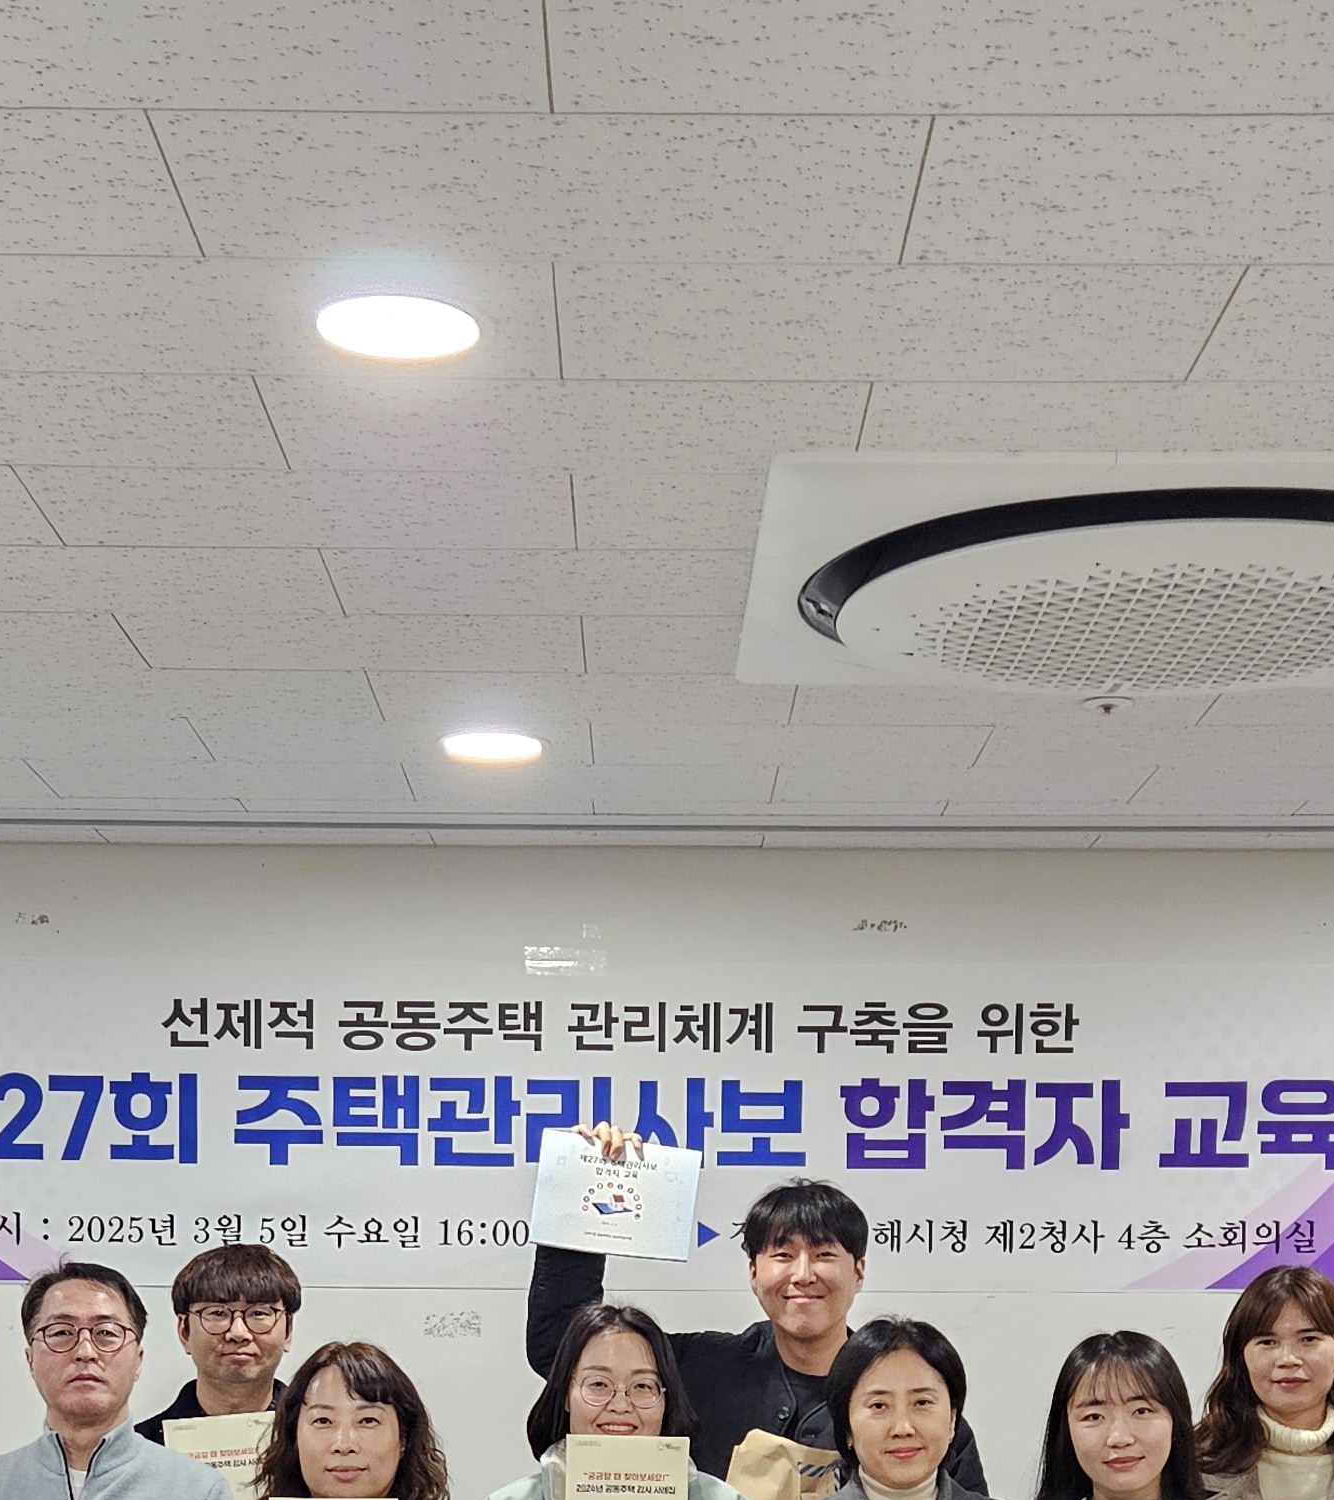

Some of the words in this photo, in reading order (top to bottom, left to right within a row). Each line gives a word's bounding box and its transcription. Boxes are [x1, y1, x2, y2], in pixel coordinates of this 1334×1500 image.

[162, 997, 315, 1050] 선제적
[339, 1000, 544, 1053] 공동주택
[568, 1001, 775, 1054] 관리체계
[798, 1002, 955, 1054] 구축을
[977, 1003, 1080, 1055] 위한
[233, 1076, 807, 1169] 주택관리사보
[839, 1078, 1131, 1172] 합격자
[67, 1213, 178, 1246] 2025년
[193, 1213, 243, 1247] 3월
[258, 1213, 308, 1247] 5일
[323, 1214, 422, 1249] 수요일
[438, 1218, 531, 1247] 16:00
[871, 1219, 970, 1256] 해시청
[984, 1220, 1106, 1256] 제2청사
[1118, 1220, 1172, 1256] 4층
[1181, 1220, 1319, 1257] 소회의실
